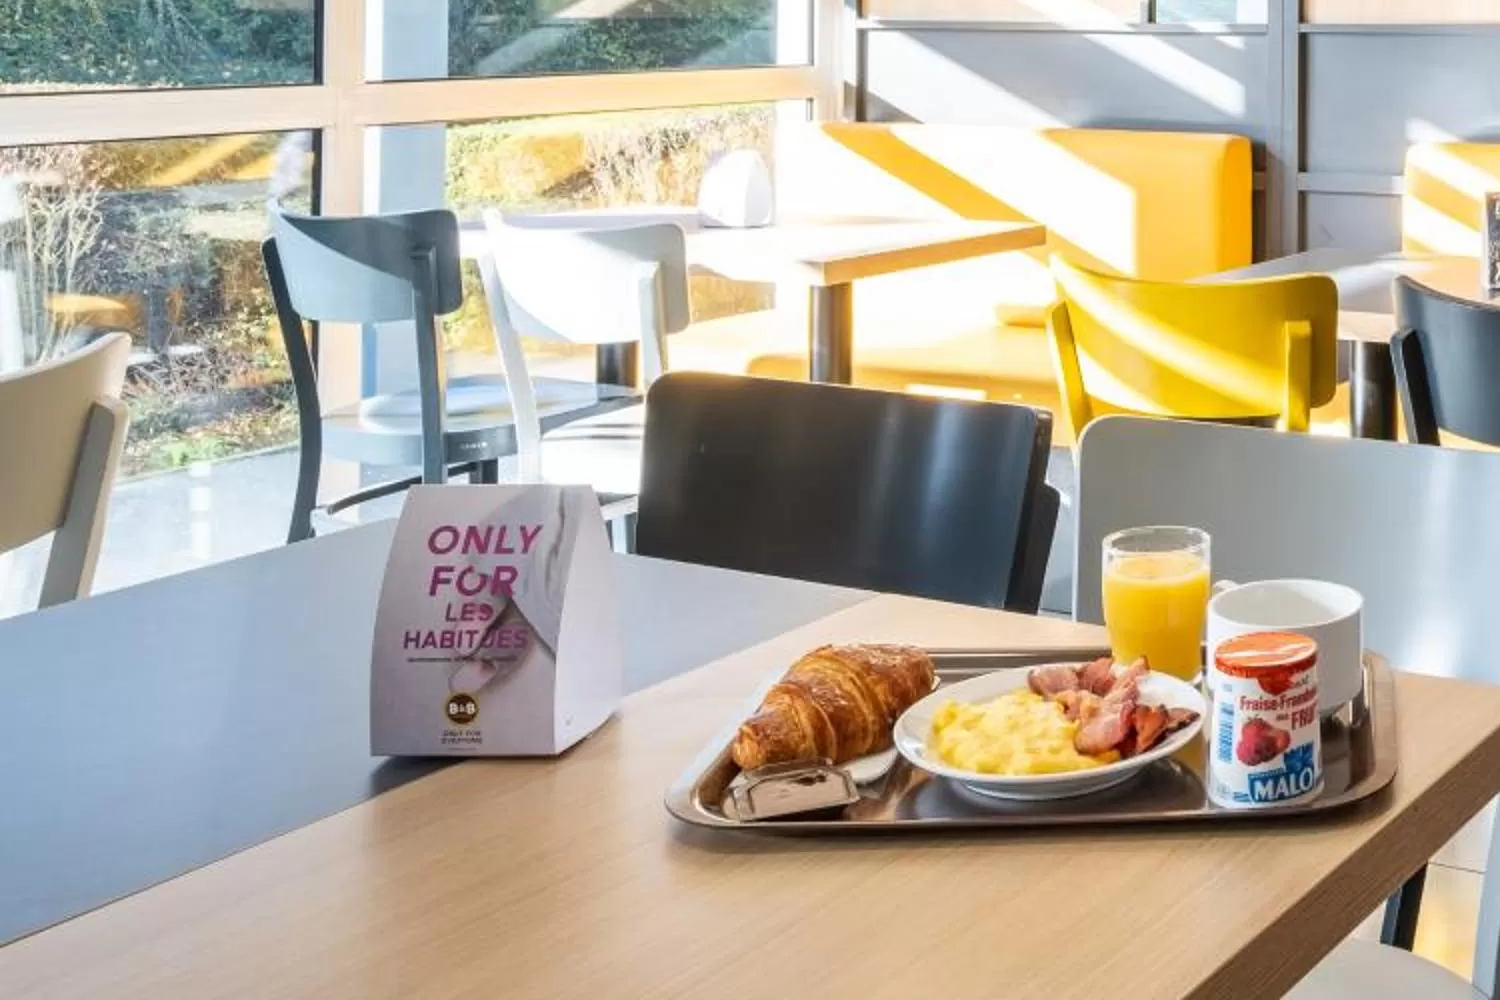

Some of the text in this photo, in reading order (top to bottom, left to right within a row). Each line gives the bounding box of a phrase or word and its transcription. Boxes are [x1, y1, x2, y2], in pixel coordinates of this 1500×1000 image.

[427, 524, 544, 555] ONLY
[429, 564, 519, 597] FOR
[445, 603, 494, 622] LES
[1254, 768, 1313, 800] MALO
